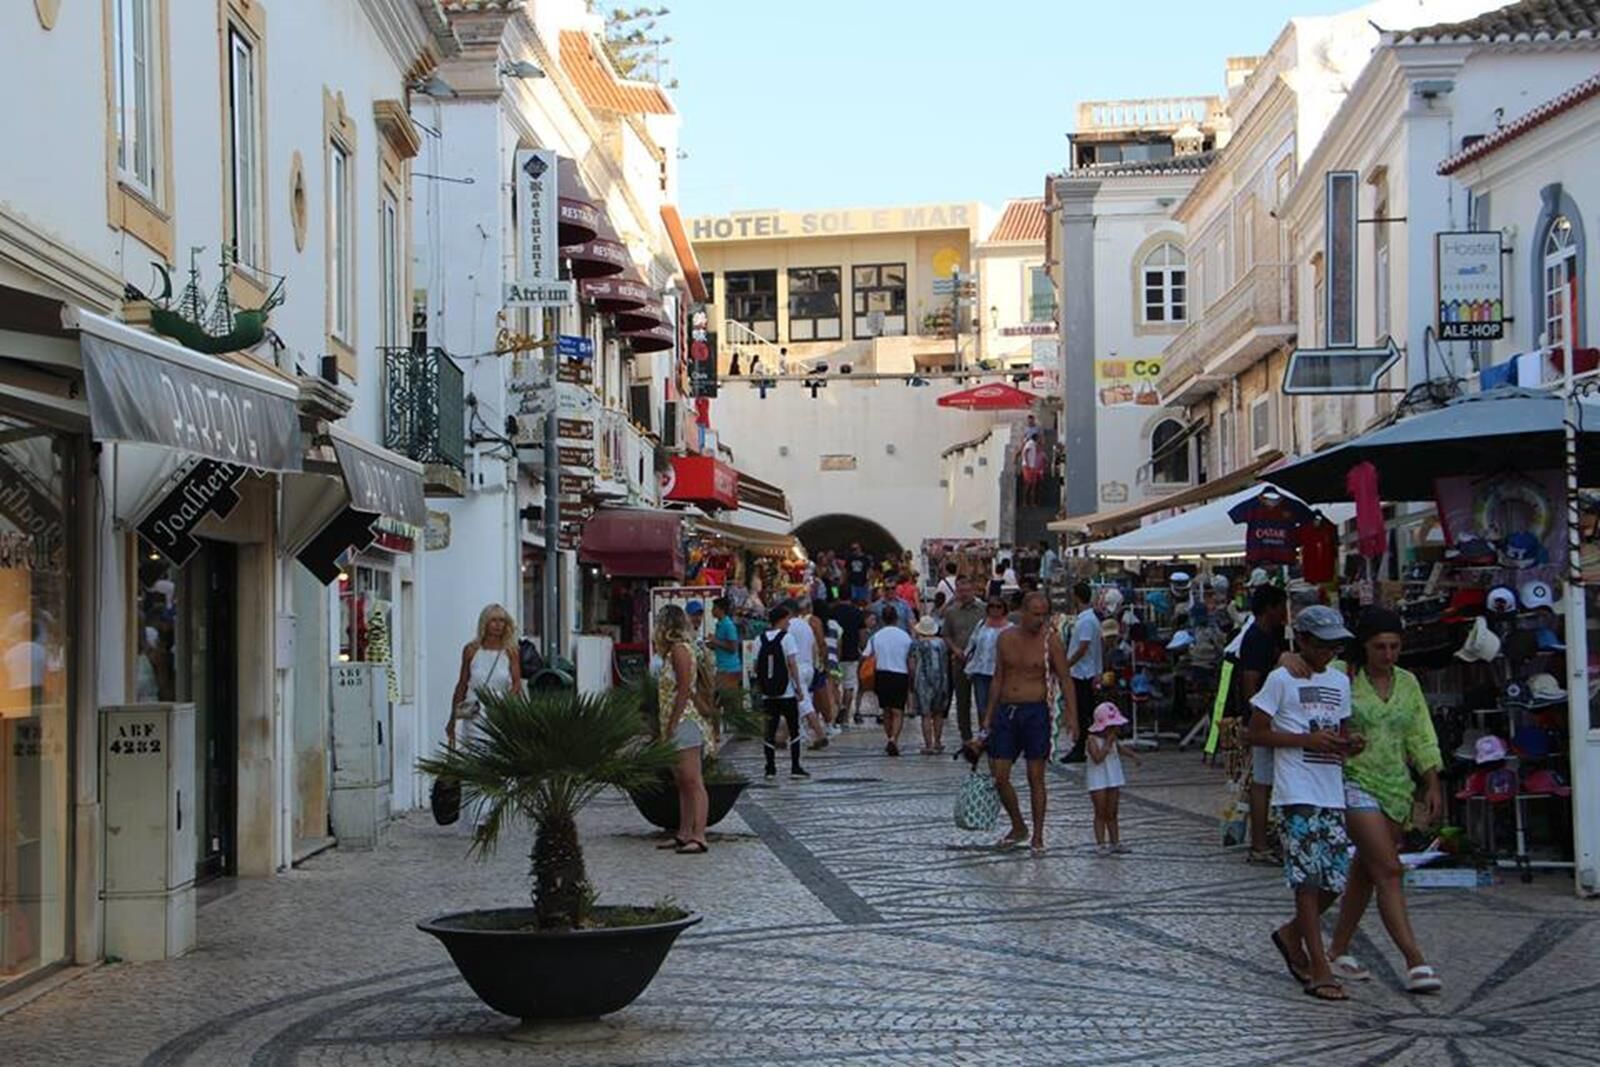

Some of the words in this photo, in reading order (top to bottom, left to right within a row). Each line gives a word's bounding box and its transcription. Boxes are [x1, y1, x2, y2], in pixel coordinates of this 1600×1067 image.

[530, 181, 543, 278] Restaurante
[693, 215, 788, 239] HOTEL
[802, 211, 855, 233] SOL
[872, 210, 888, 229] E
[904, 205, 968, 228] MAR
[1444, 240, 1498, 255] Hostel
[507, 285, 568, 301] Atrium
[1443, 323, 1501, 337] ALE-HOP
[118, 723, 156, 738] ABF
